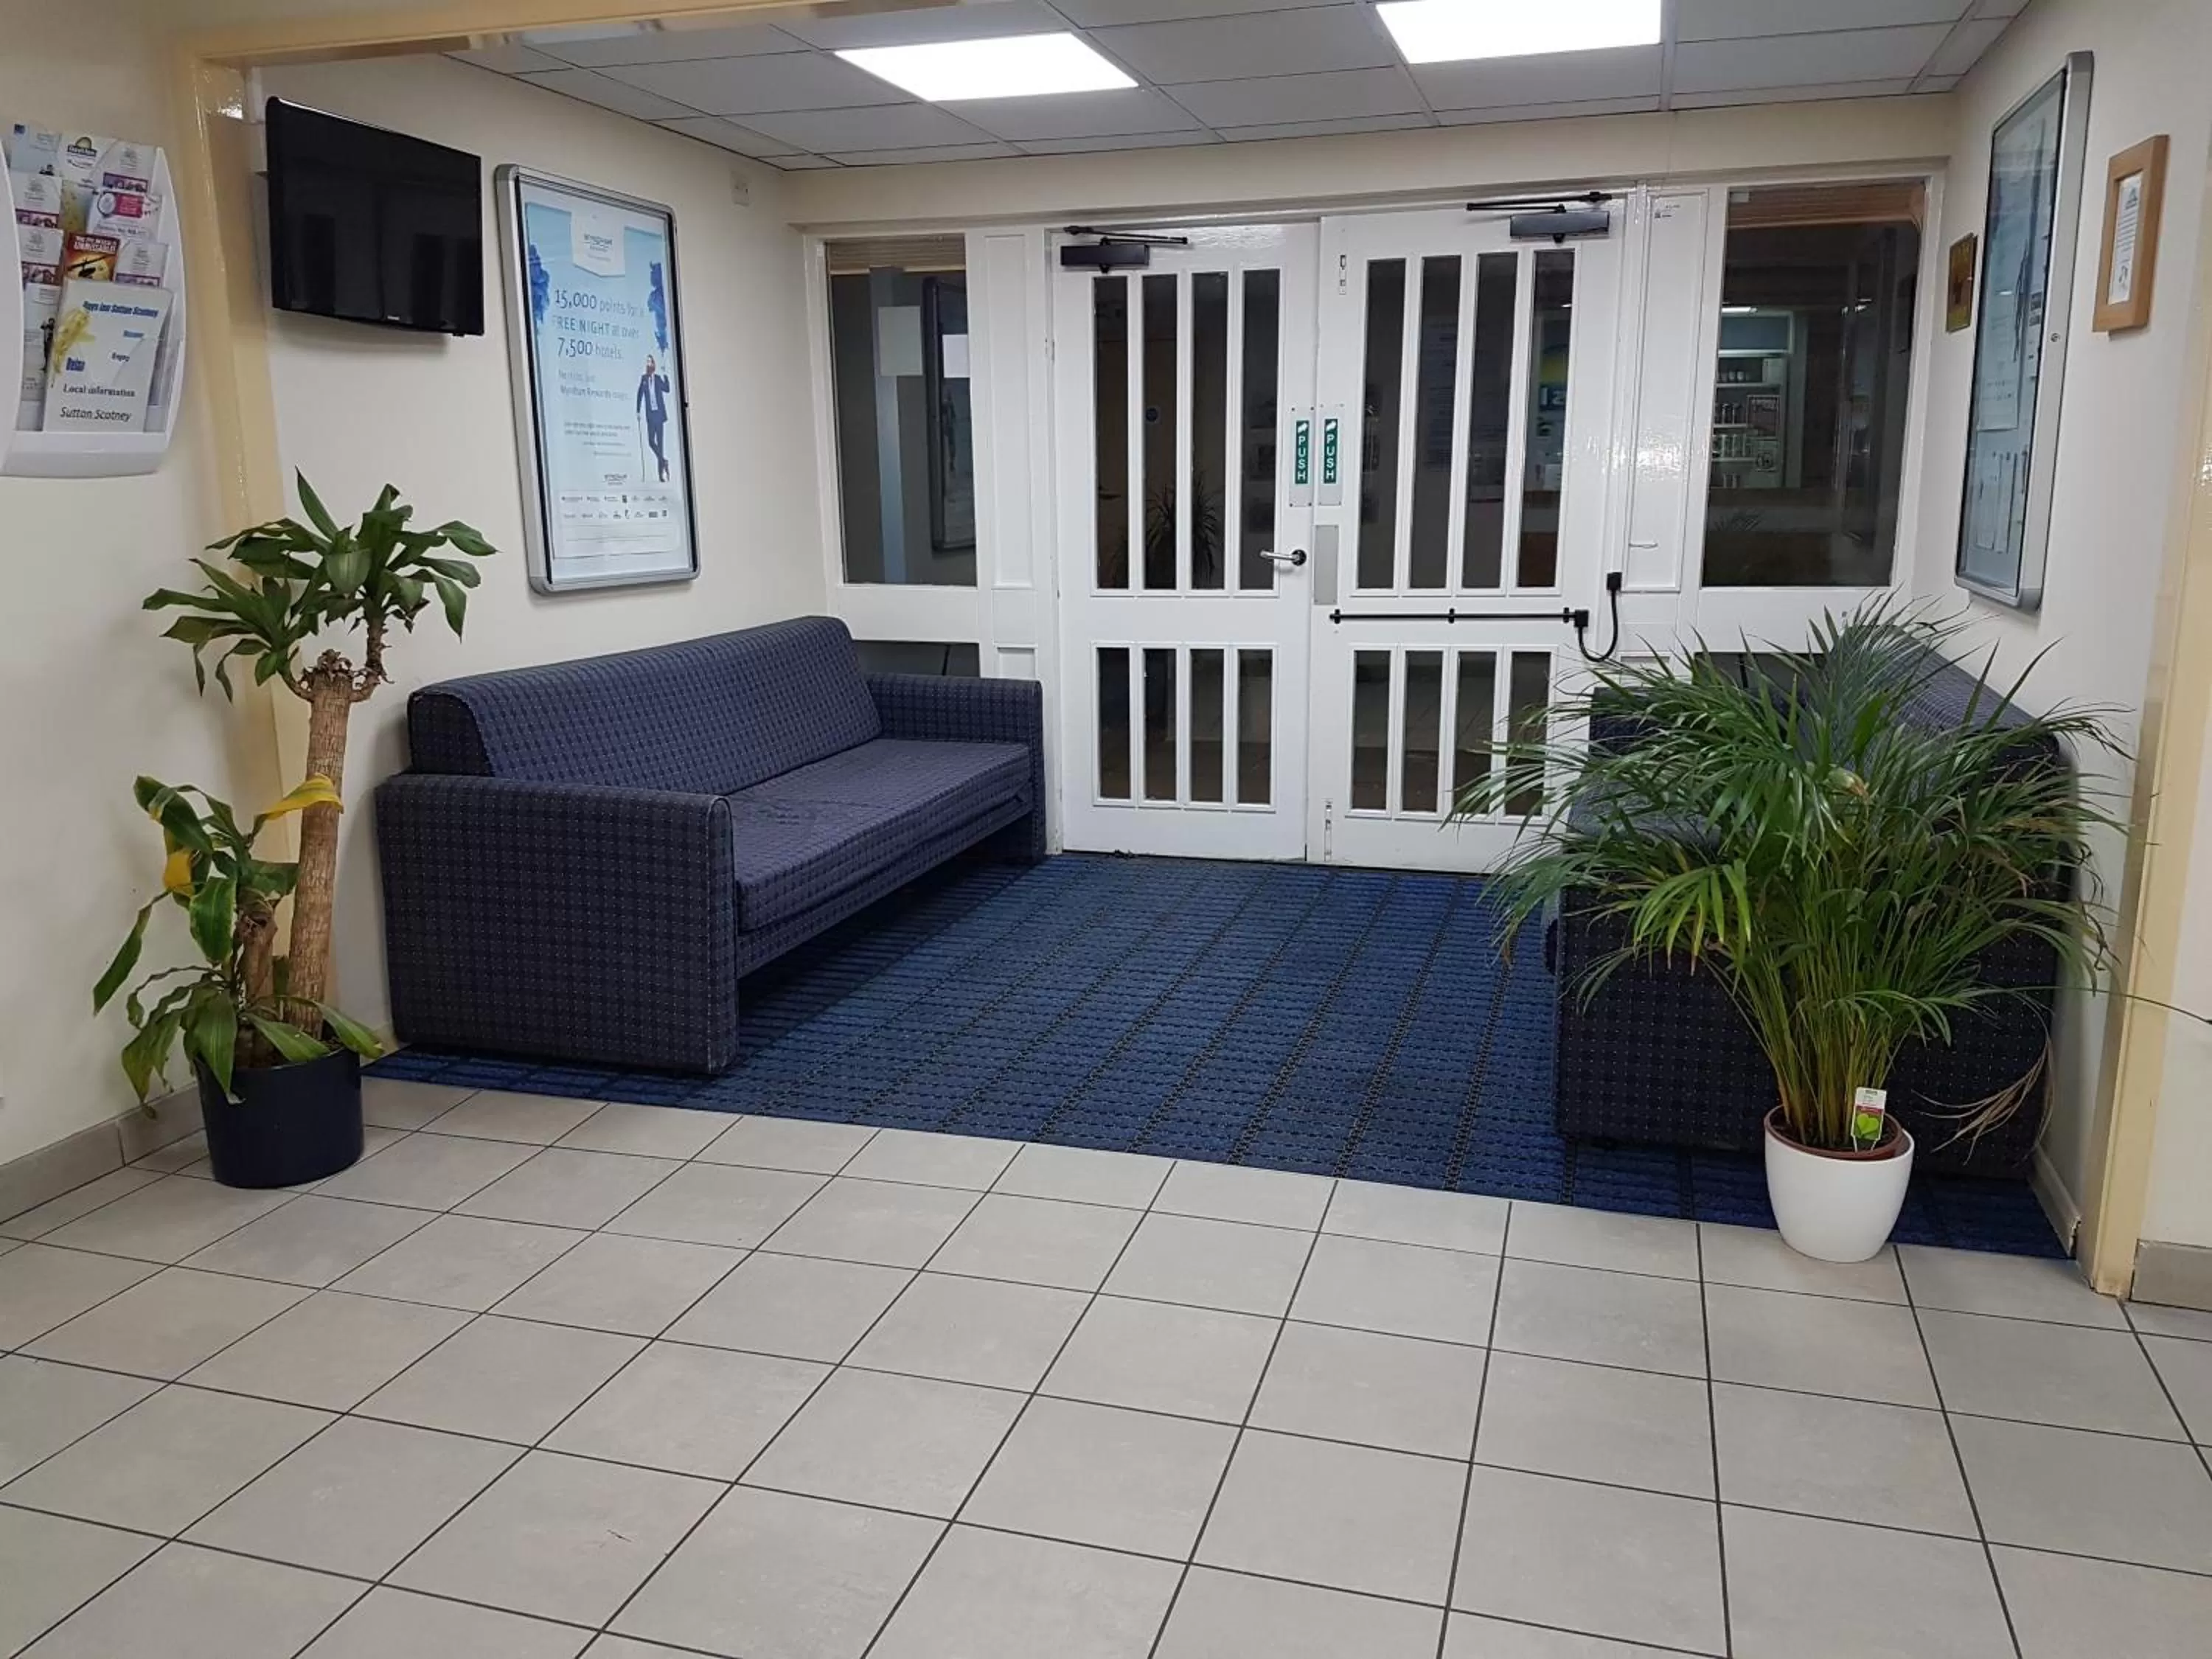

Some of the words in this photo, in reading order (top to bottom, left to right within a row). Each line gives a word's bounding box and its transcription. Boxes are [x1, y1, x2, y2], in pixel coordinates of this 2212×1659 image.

[554, 289, 597, 309] 15,000
[552, 316, 576, 331] FREE
[579, 319, 611, 335] NIGHT
[557, 337, 593, 358] 7,500
[63, 383, 86, 393] Local
[88, 386, 136, 397] information
[60, 406, 92, 420] Sutton
[94, 409, 132, 422] Scotney
[1298, 436, 1307, 481] PUSH
[1326, 434, 1335, 480] PUSH
